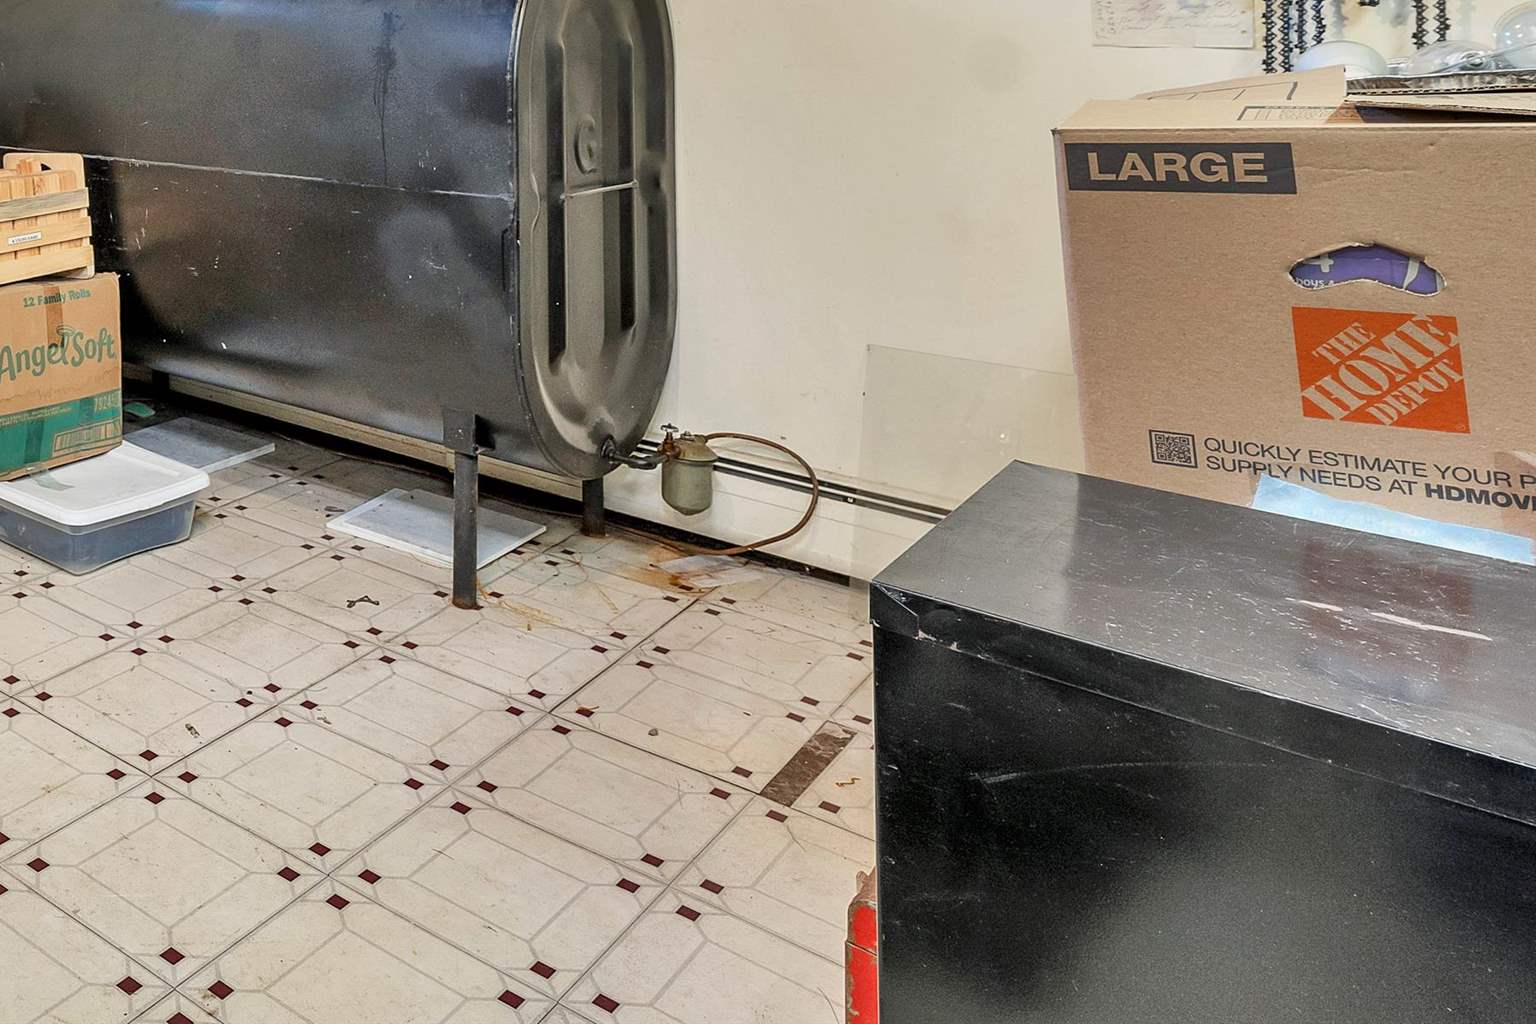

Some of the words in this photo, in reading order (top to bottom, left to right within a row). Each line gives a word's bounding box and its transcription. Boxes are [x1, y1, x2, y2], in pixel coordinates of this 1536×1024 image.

[1087, 151, 1268, 184] LARGE
[23, 296, 35, 308] 12
[37, 291, 66, 306] Family
[67, 288, 92, 302] Rolls
[70, 328, 117, 368] Soft
[1301, 313, 1460, 421] HOME
[1312, 321, 1377, 366] THE
[1366, 358, 1464, 426] DEPOT
[1204, 437, 1301, 463] QUICKLY
[1309, 449, 1428, 478] ESTIMATE
[1434, 462, 1512, 489] YOUR
[1520, 474, 1536, 490] P
[1205, 455, 1293, 480] SUPPLY
[1300, 466, 1381, 492] NEEDS
[1388, 479, 1418, 496] AT
[1425, 484, 1536, 512] HDMOV
